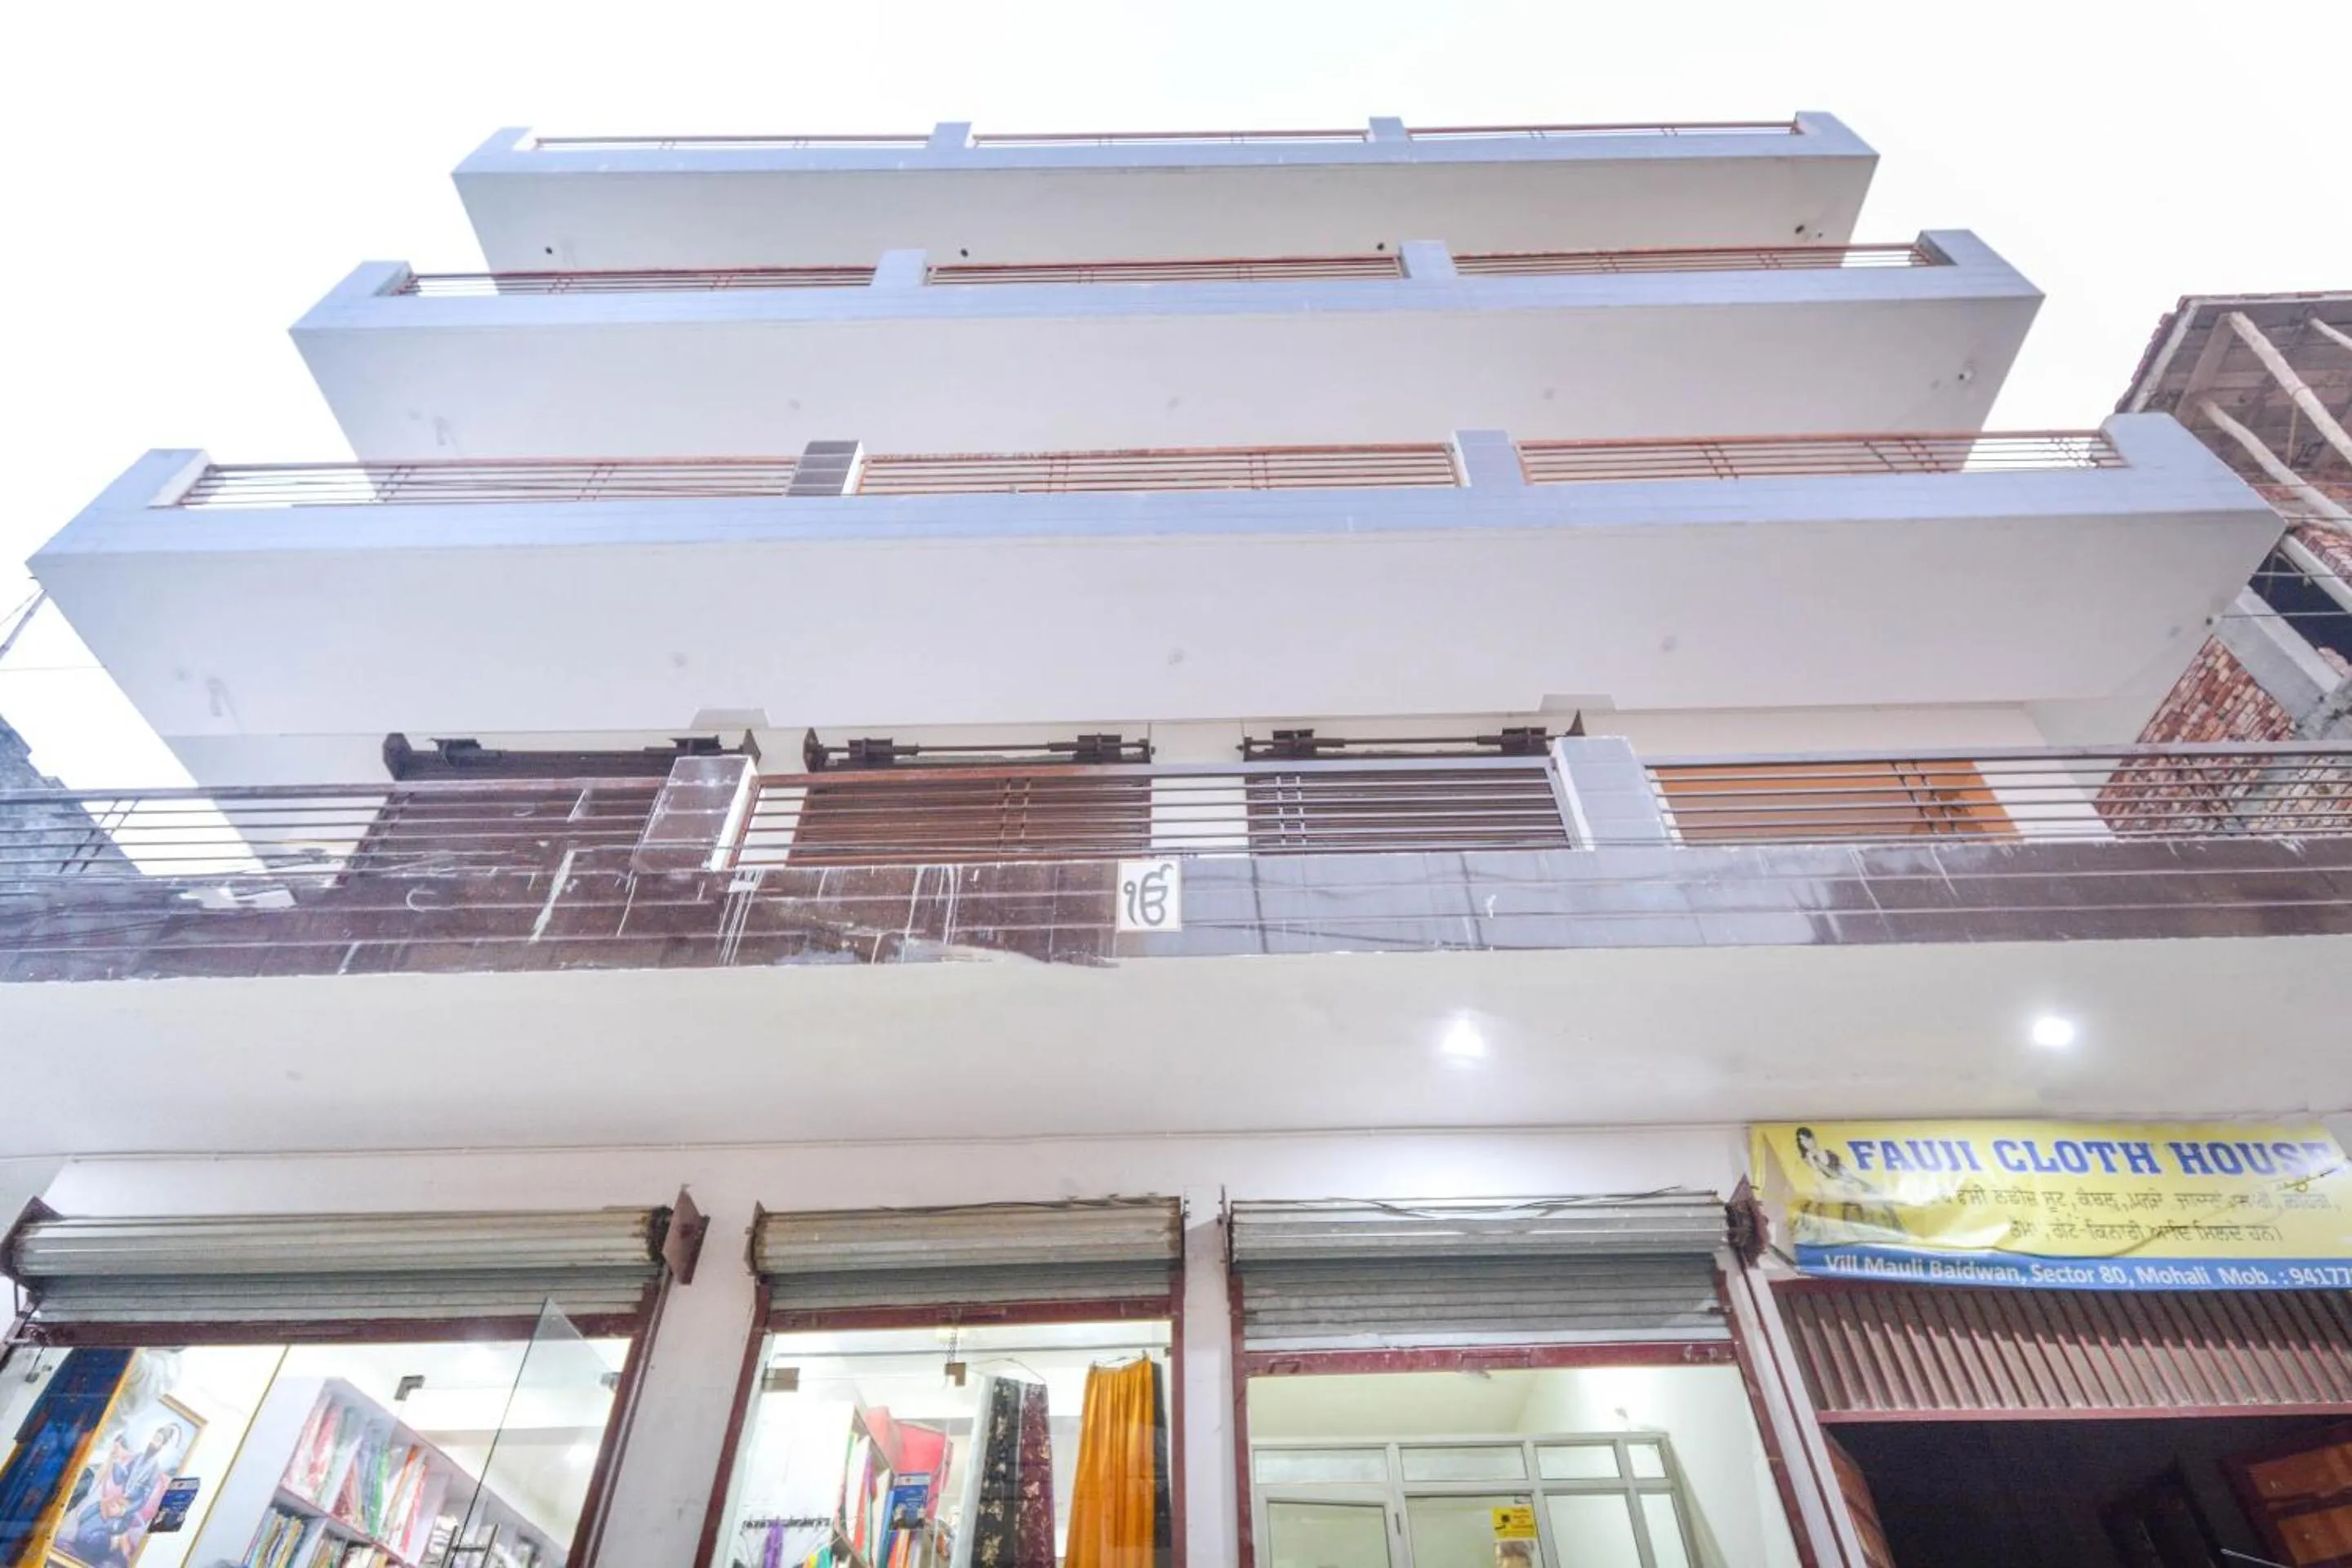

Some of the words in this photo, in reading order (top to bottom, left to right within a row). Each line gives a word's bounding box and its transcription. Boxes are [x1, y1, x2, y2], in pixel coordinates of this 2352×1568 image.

[1846, 1140, 1983, 1172] FAUJI
[1992, 1140, 2162, 1174] CLOTH
[1824, 1254, 1859, 1272] Vill
[1864, 1256, 1922, 1277] Mauli
[2030, 1264, 2095, 1284] Sector
[2099, 1266, 2136, 1288] 80,
[2136, 1266, 2211, 1285] Mohali
[2289, 1267, 2352, 1285] 94177
